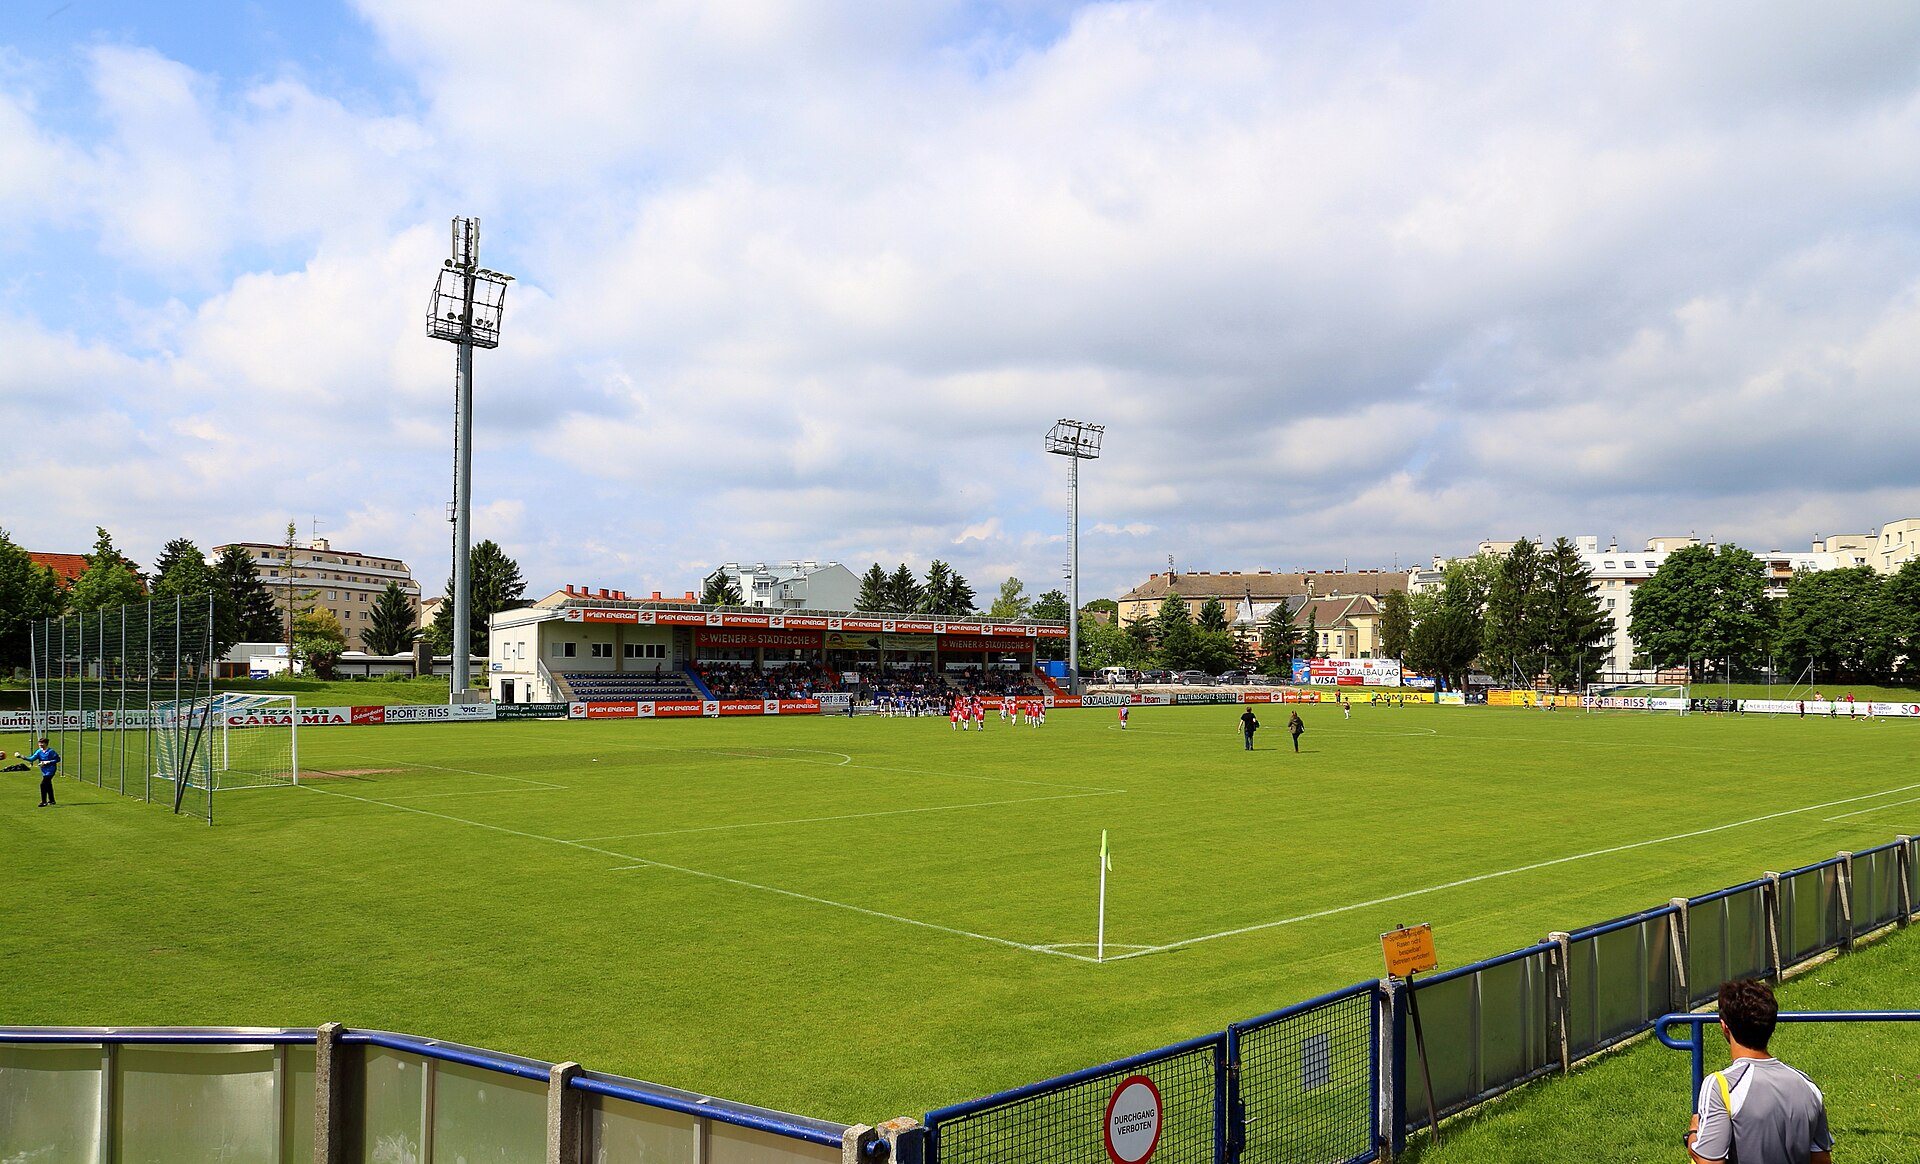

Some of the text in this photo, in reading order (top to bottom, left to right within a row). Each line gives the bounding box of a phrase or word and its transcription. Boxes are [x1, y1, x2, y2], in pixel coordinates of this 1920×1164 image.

[710, 634, 747, 644] WIENER
[949, 640, 978, 648] WIENER
[1339, 668, 1384, 676] SOZIALBAU
[1386, 668, 1398, 676] AG
[1314, 676, 1336, 684] VISA
[1082, 696, 1118, 705] SOZIALBAU
[1120, 695, 1130, 704] AG
[1144, 696, 1160, 704] team
[1376, 694, 1426, 702] ADMRAL
[1624, 698, 1644, 707] RISS
[386, 708, 449, 718] SPORT RISS
[0, 716, 44, 726] ünther
[228, 714, 346, 726] CARA MIA
[1114, 1108, 1155, 1125] DURCHGANG
[1118, 1120, 1152, 1136] VERBOTEN
